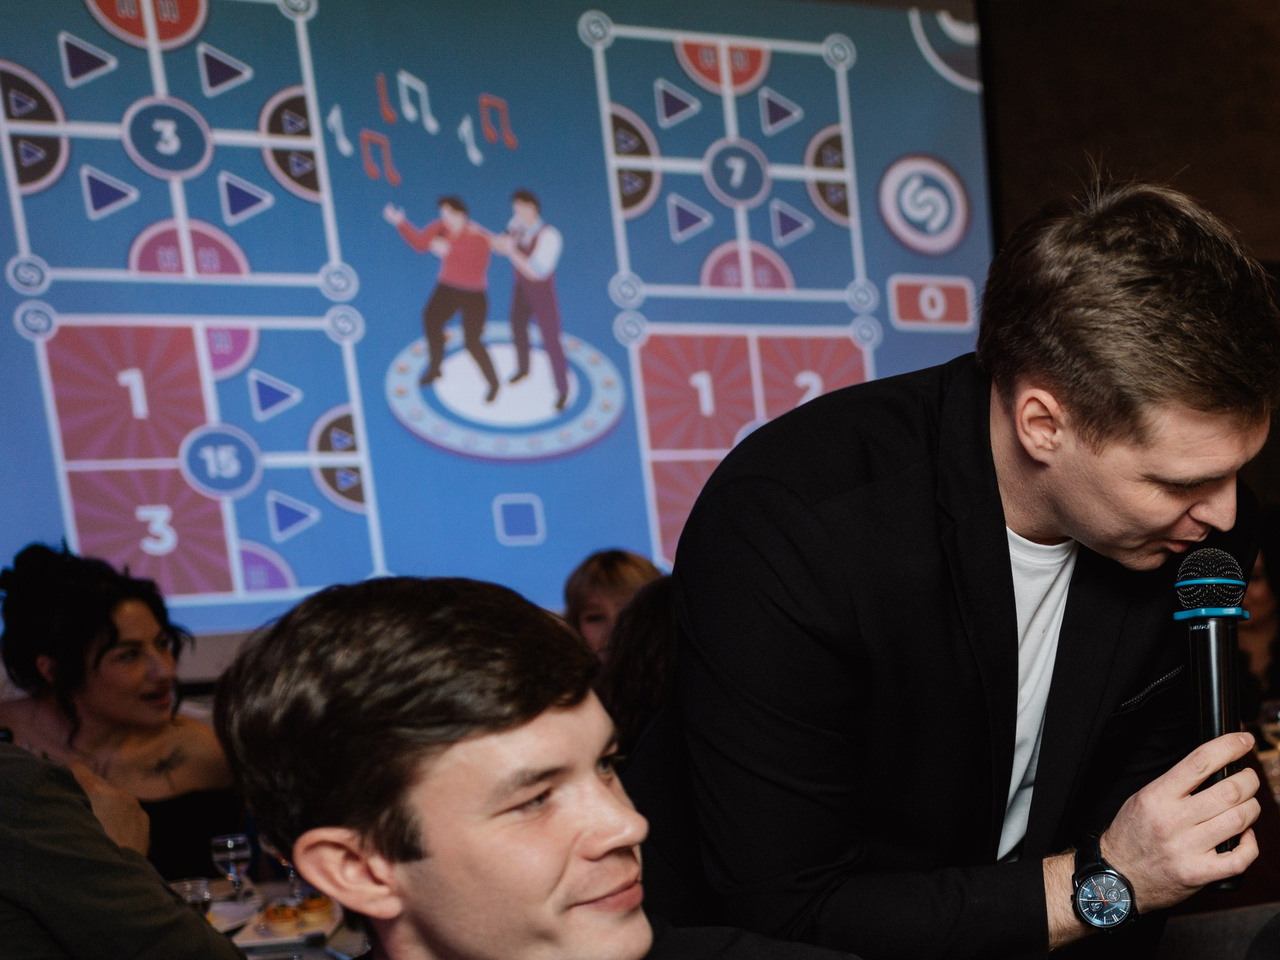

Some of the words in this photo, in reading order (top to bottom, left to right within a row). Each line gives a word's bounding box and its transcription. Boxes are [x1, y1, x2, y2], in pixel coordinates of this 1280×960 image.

[152, 118, 181, 156] 3
[918, 285, 946, 322] 0
[117, 368, 149, 419] 1
[689, 371, 715, 417] 1
[199, 446, 240, 480] 15
[135, 503, 178, 556] 3
